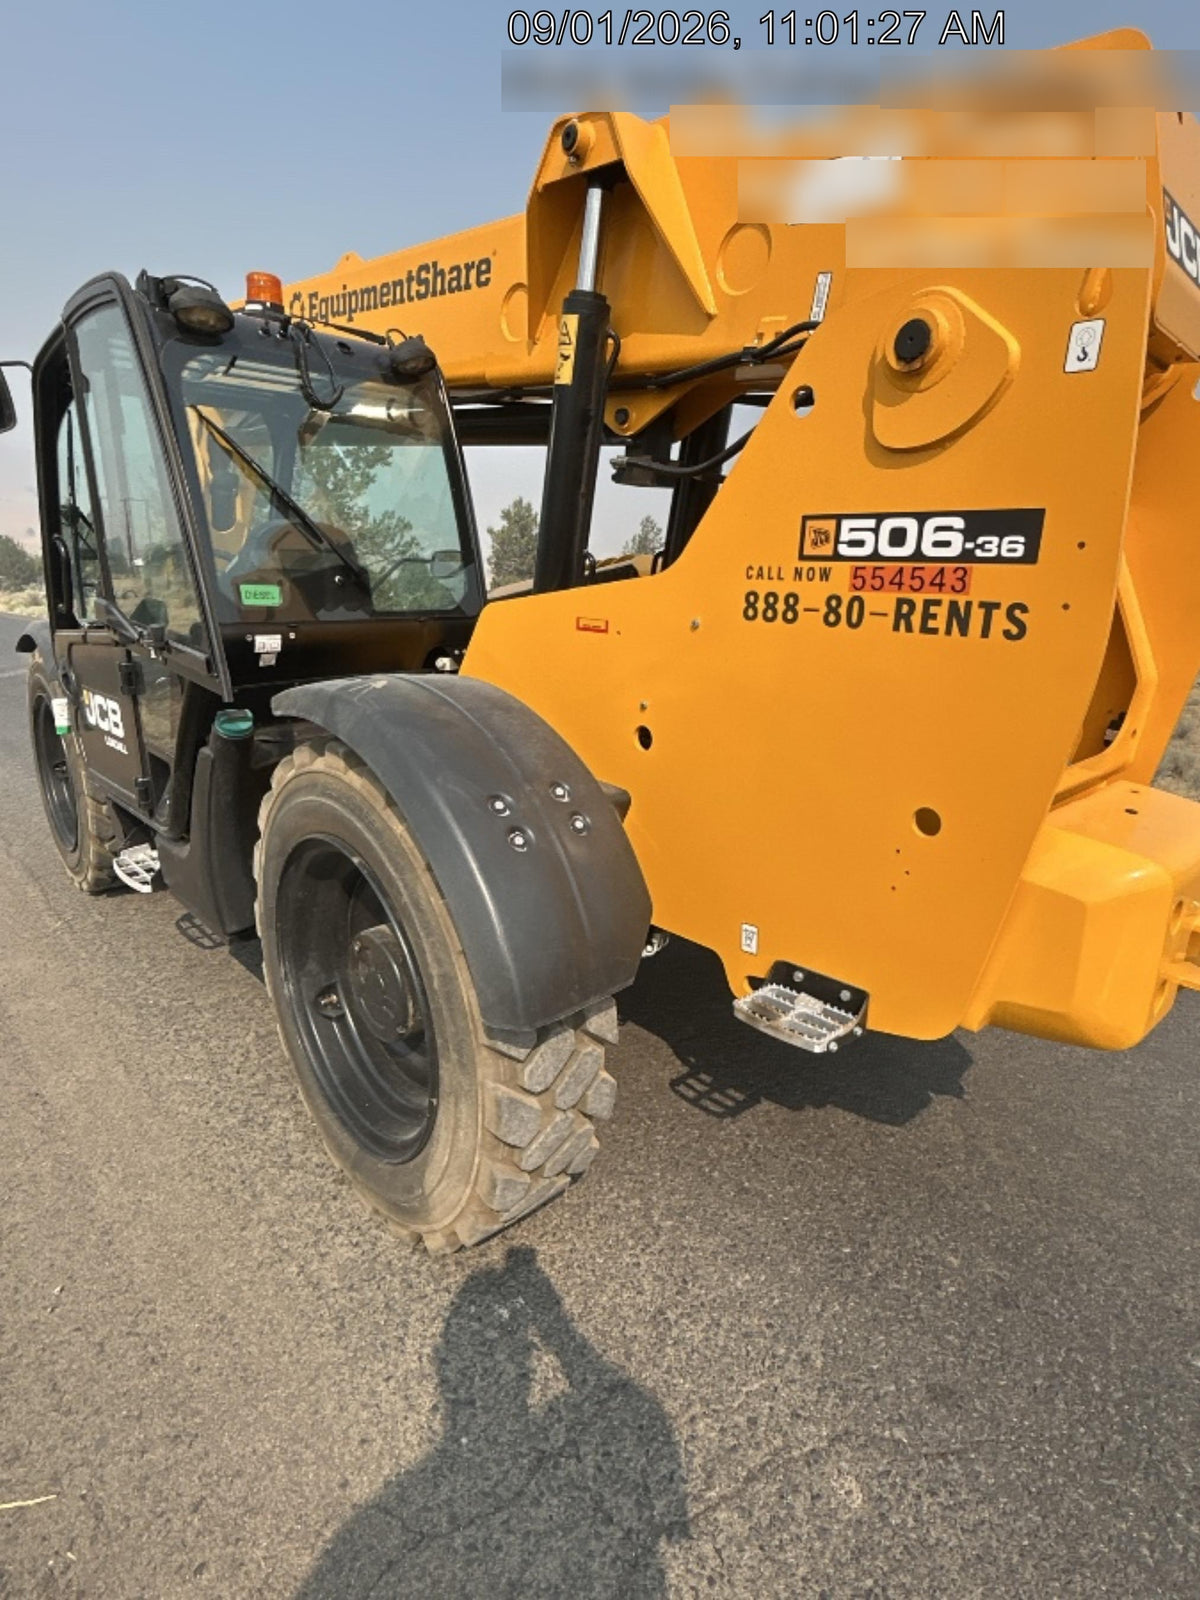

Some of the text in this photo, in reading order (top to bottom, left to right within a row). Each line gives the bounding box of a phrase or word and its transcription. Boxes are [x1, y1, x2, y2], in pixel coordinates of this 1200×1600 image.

[1166, 206, 1200, 286] JC
[308, 256, 492, 323] EquipmentShare
[837, 516, 1026, 558] 506-36
[745, 566, 833, 583] CALL NOW
[852, 565, 968, 593] 554543
[742, 590, 1030, 642] 888-80-RENTS
[83, 689, 125, 738] JCB
